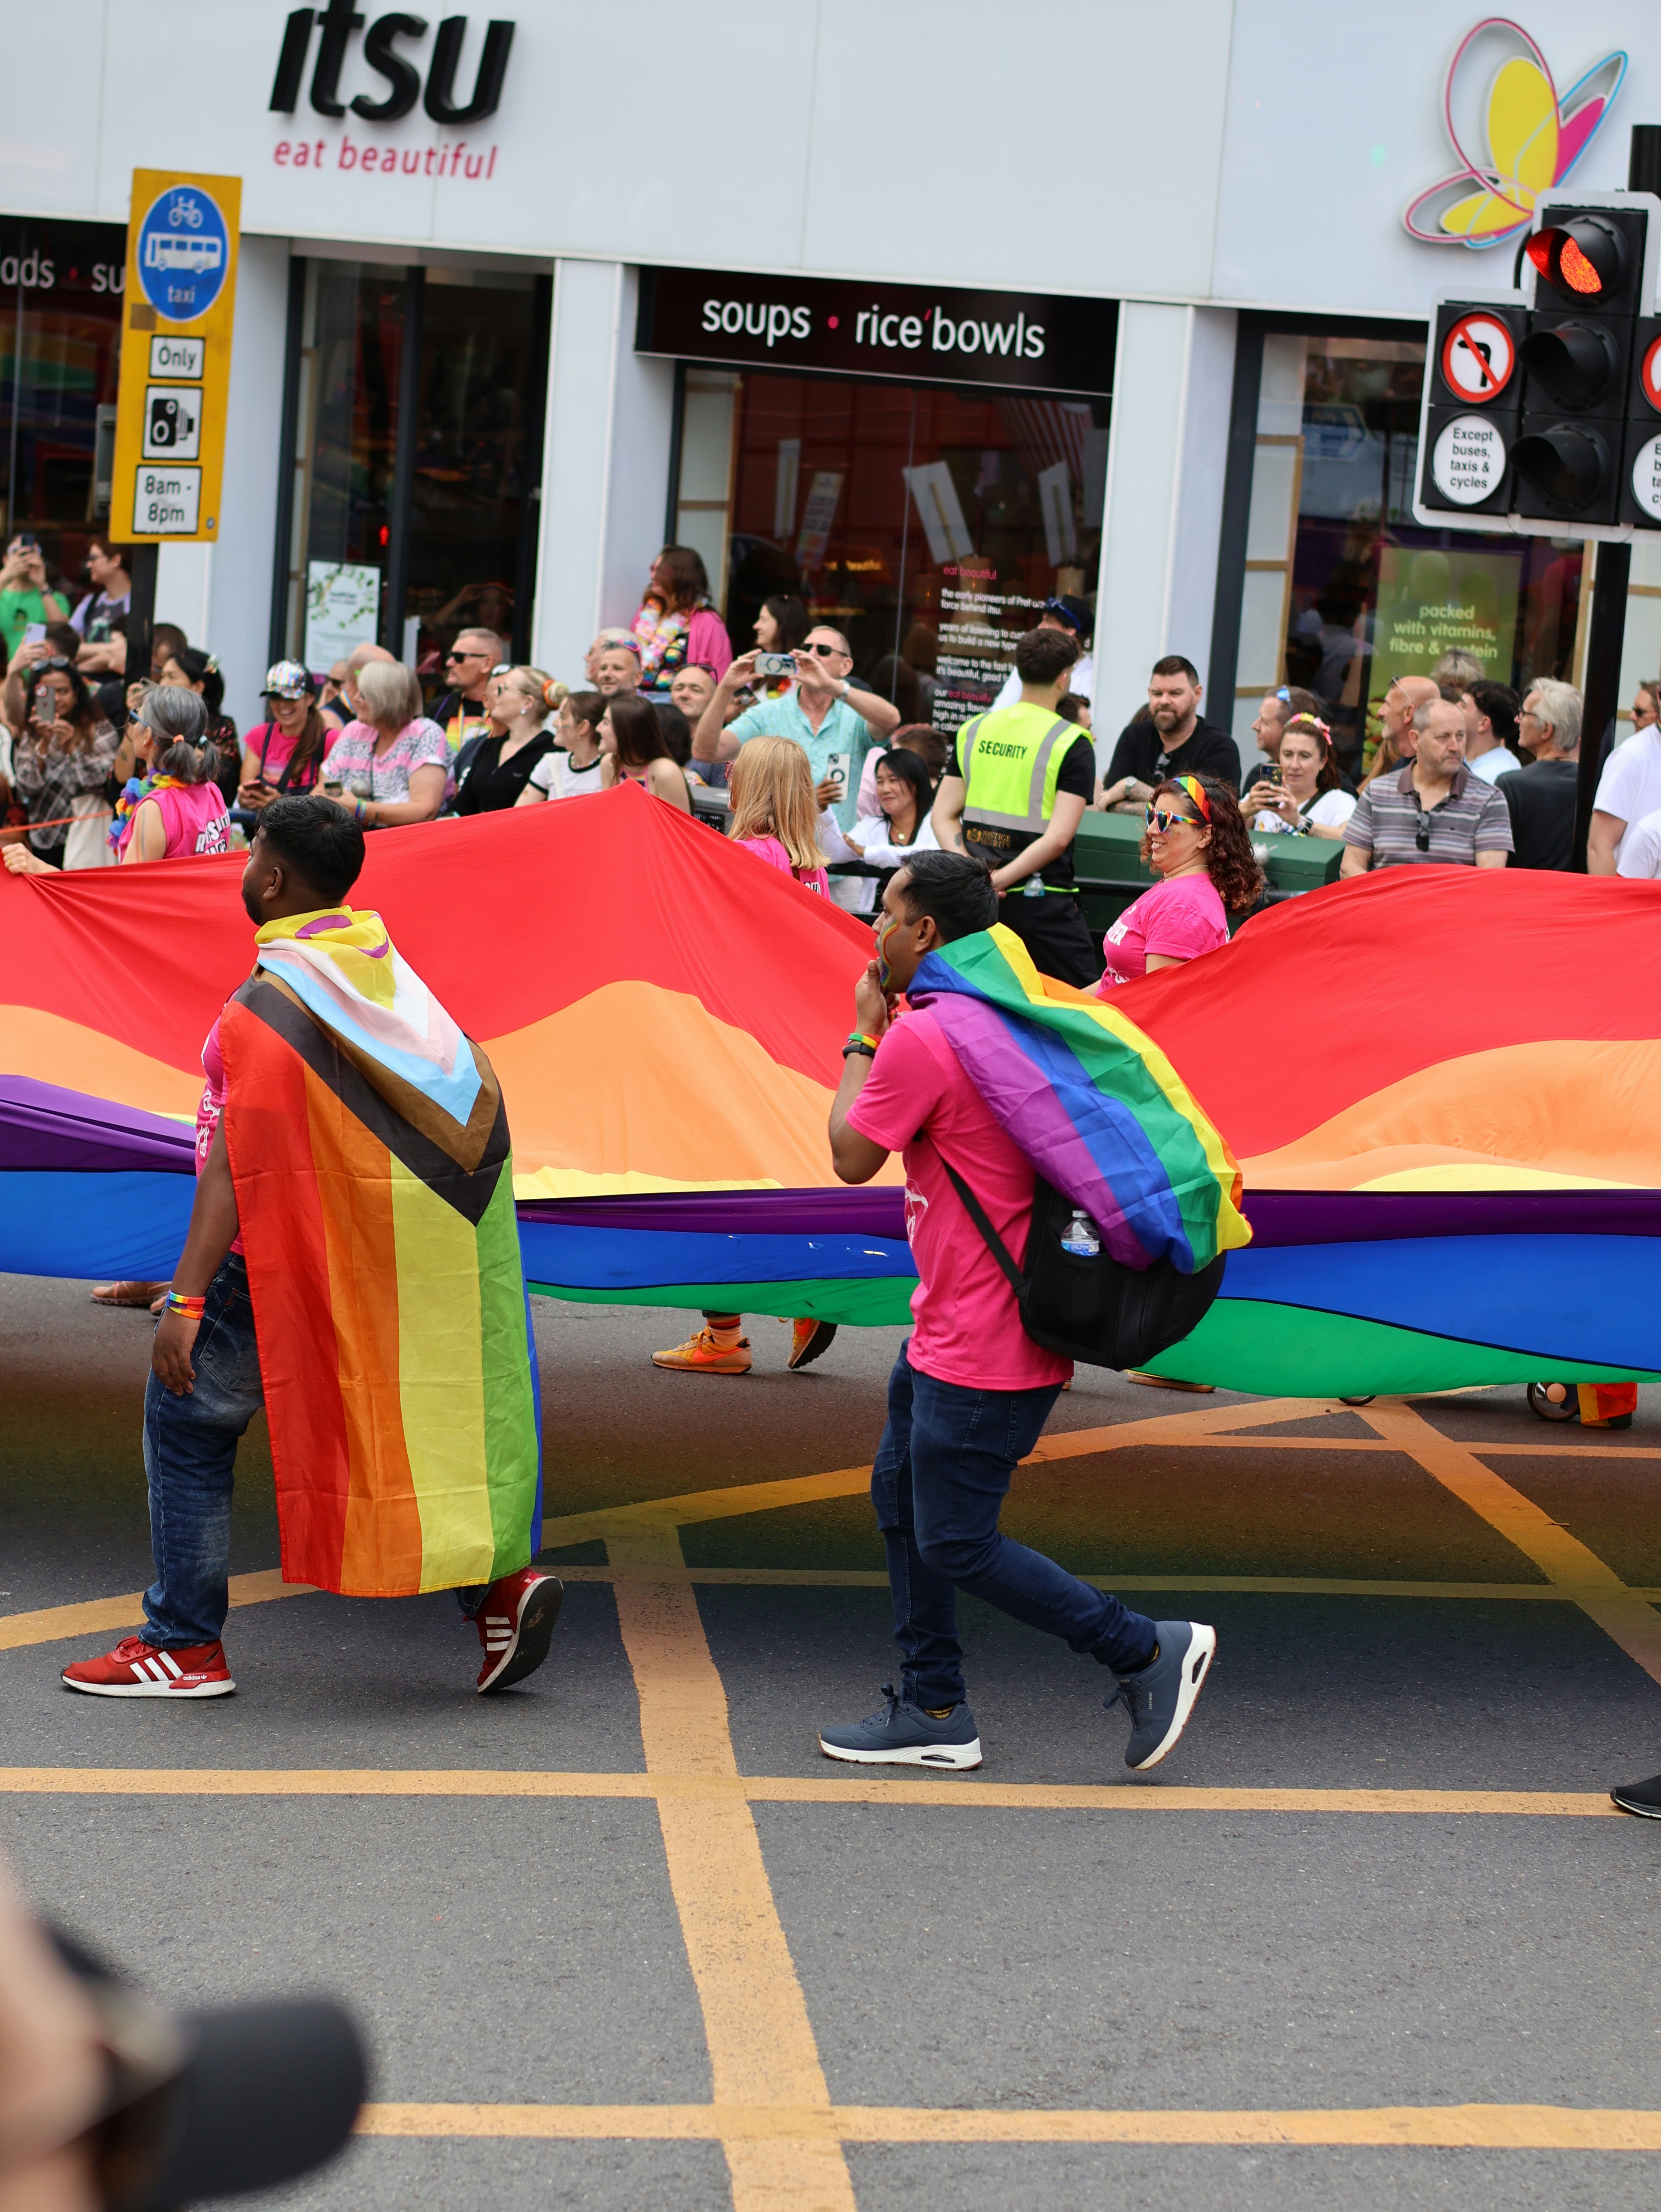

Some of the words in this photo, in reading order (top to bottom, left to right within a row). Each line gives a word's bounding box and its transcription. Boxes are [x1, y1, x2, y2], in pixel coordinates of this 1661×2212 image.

[269, 0, 516, 125] itsu
[274, 138, 327, 169] eat
[338, 136, 497, 180] beautiful
[167, 284, 196, 303] taxi
[701, 299, 811, 347] soups
[855, 303, 923, 349] rice
[932, 306, 1045, 358] bowls
[159, 346, 197, 371] Only
[1453, 428, 1493, 444] Except
[1452, 443, 1491, 458] buses,
[1450, 460, 1477, 472] taxis
[1482, 461, 1490, 472] &
[145, 475, 181, 494] 8am
[1450, 477, 1487, 490] cycles
[148, 502, 184, 526] 8pm
[943, 566, 958, 576] eat
[960, 566, 996, 580] beautiful
[941, 588, 953, 599] the
[955, 591, 973, 602] early
[975, 594, 1006, 605] pioneers
[1007, 595, 1015, 605] of
[1016, 597, 1031, 607] Pret
[940, 599, 959, 610] force
[960, 602, 986, 613] behind
[1419, 604, 1475, 620] packed
[940, 623, 959, 632] years
[961, 624, 969, 633] of
[970, 626, 999, 639] listening
[1002, 629, 1008, 638] to
[1393, 620, 1426, 636] with
[1430, 622, 1496, 642] vitamins,
[950, 634, 956, 643] to
[958, 635, 975, 645] build
[985, 640, 1000, 648] new
[1002, 640, 1017, 651] type
[1390, 638, 1424, 654] fibre
[1428, 640, 1440, 655] &
[1445, 643, 1497, 659] tein
[937, 656, 970, 667] welcome
[972, 658, 978, 668] to
[980, 659, 992, 669] the
[994, 661, 1007, 671] fast
[937, 665, 946, 675] it's
[948, 666, 980, 680] beautiful,
[982, 672, 1001, 683] good
[948, 690, 960, 698] eat
[934, 700, 965, 712] amazing
[933, 709, 949, 721] high
[951, 712, 958, 720] in
[933, 720, 939, 729] in
[978, 740, 1028, 760] SECURITY
